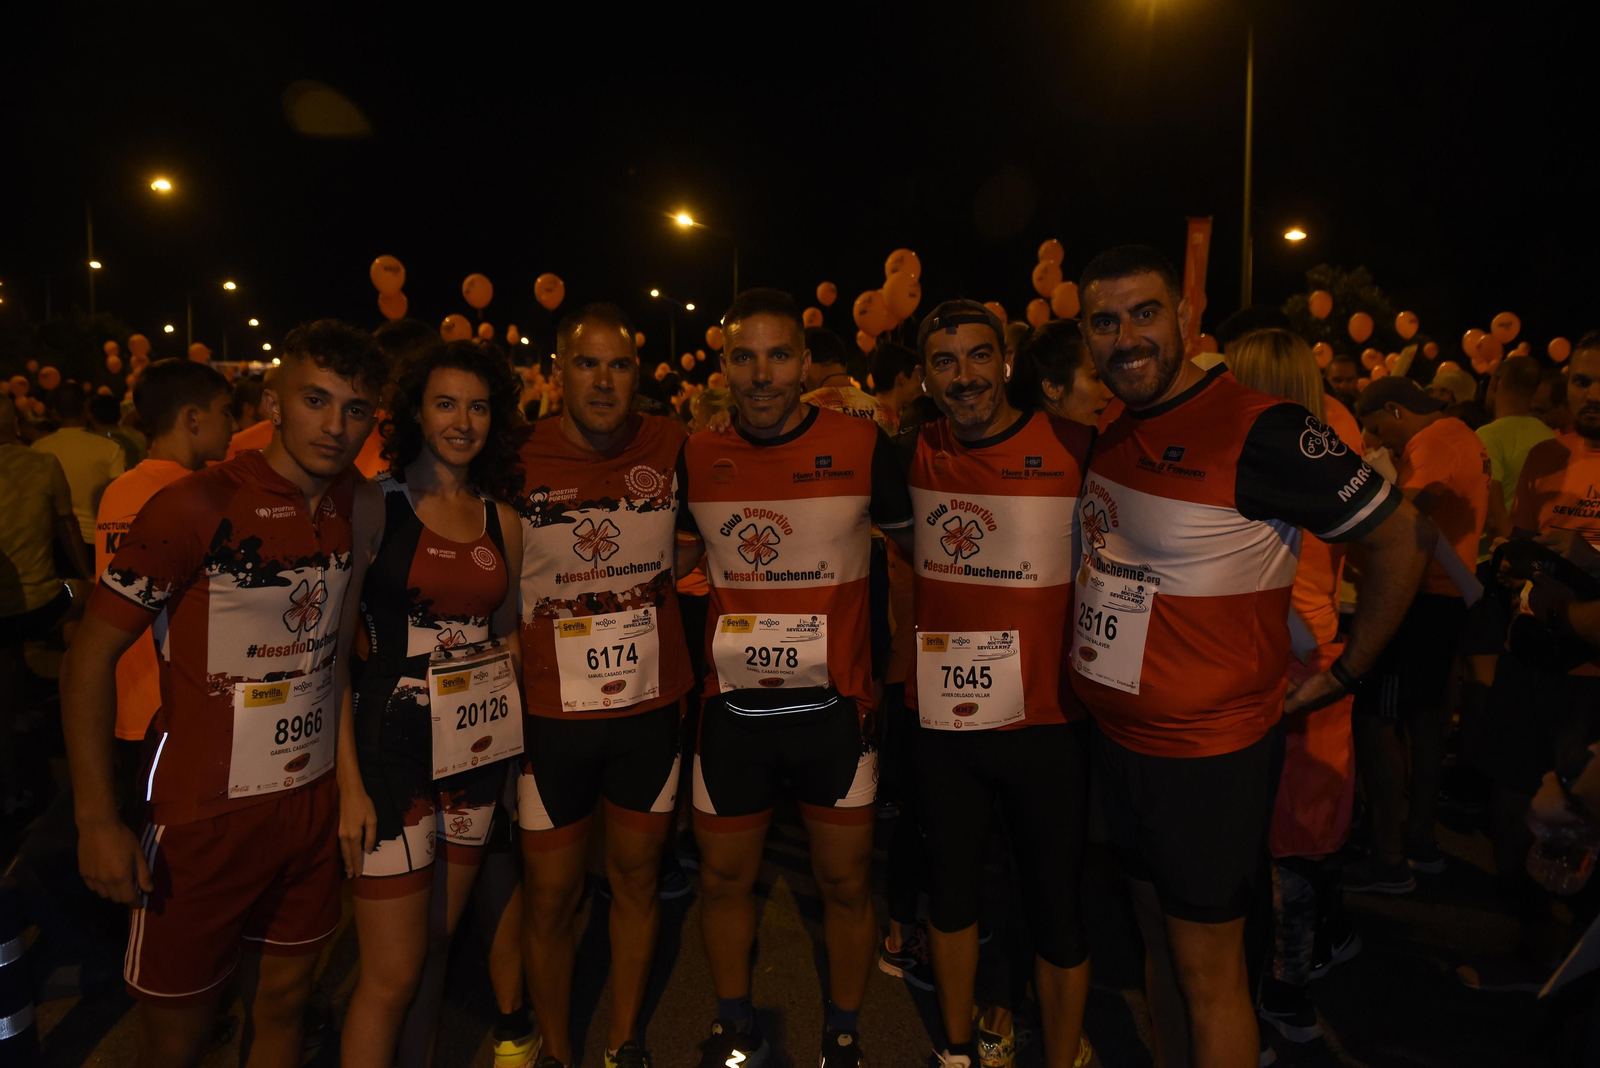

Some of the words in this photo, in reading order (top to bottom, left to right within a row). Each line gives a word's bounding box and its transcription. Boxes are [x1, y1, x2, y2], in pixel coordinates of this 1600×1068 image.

[1167, 464, 1206, 478] FERNANDO
[548, 488, 578, 496] SPORTING
[548, 494, 577, 502] PURSUITS
[272, 511, 297, 519] PURSUITS
[927, 504, 948, 526] Club
[950, 499, 997, 532] Deportivo
[1089, 480, 1119, 529] Deportivo
[1553, 505, 1594, 518] SEVILLA
[720, 513, 742, 537] Club
[743, 507, 794, 536] Deportivo
[555, 560, 661, 585] #desafioDuchenne
[724, 570, 835, 582] #desafioDuchenne.org
[923, 559, 1038, 581] #desafioDuchenne.org
[1110, 592, 1131, 602] SEVILLA
[1121, 590, 1145, 600] NOCTURNA
[1078, 602, 1118, 640] 2516
[587, 643, 638, 670] 6174
[745, 646, 798, 668] 2978
[941, 666, 992, 689] 7645
[456, 694, 508, 730] 20126
[275, 707, 323, 745] 8966
[270, 748, 292, 756] GABRIEL
[293, 743, 310, 752] CASADO
